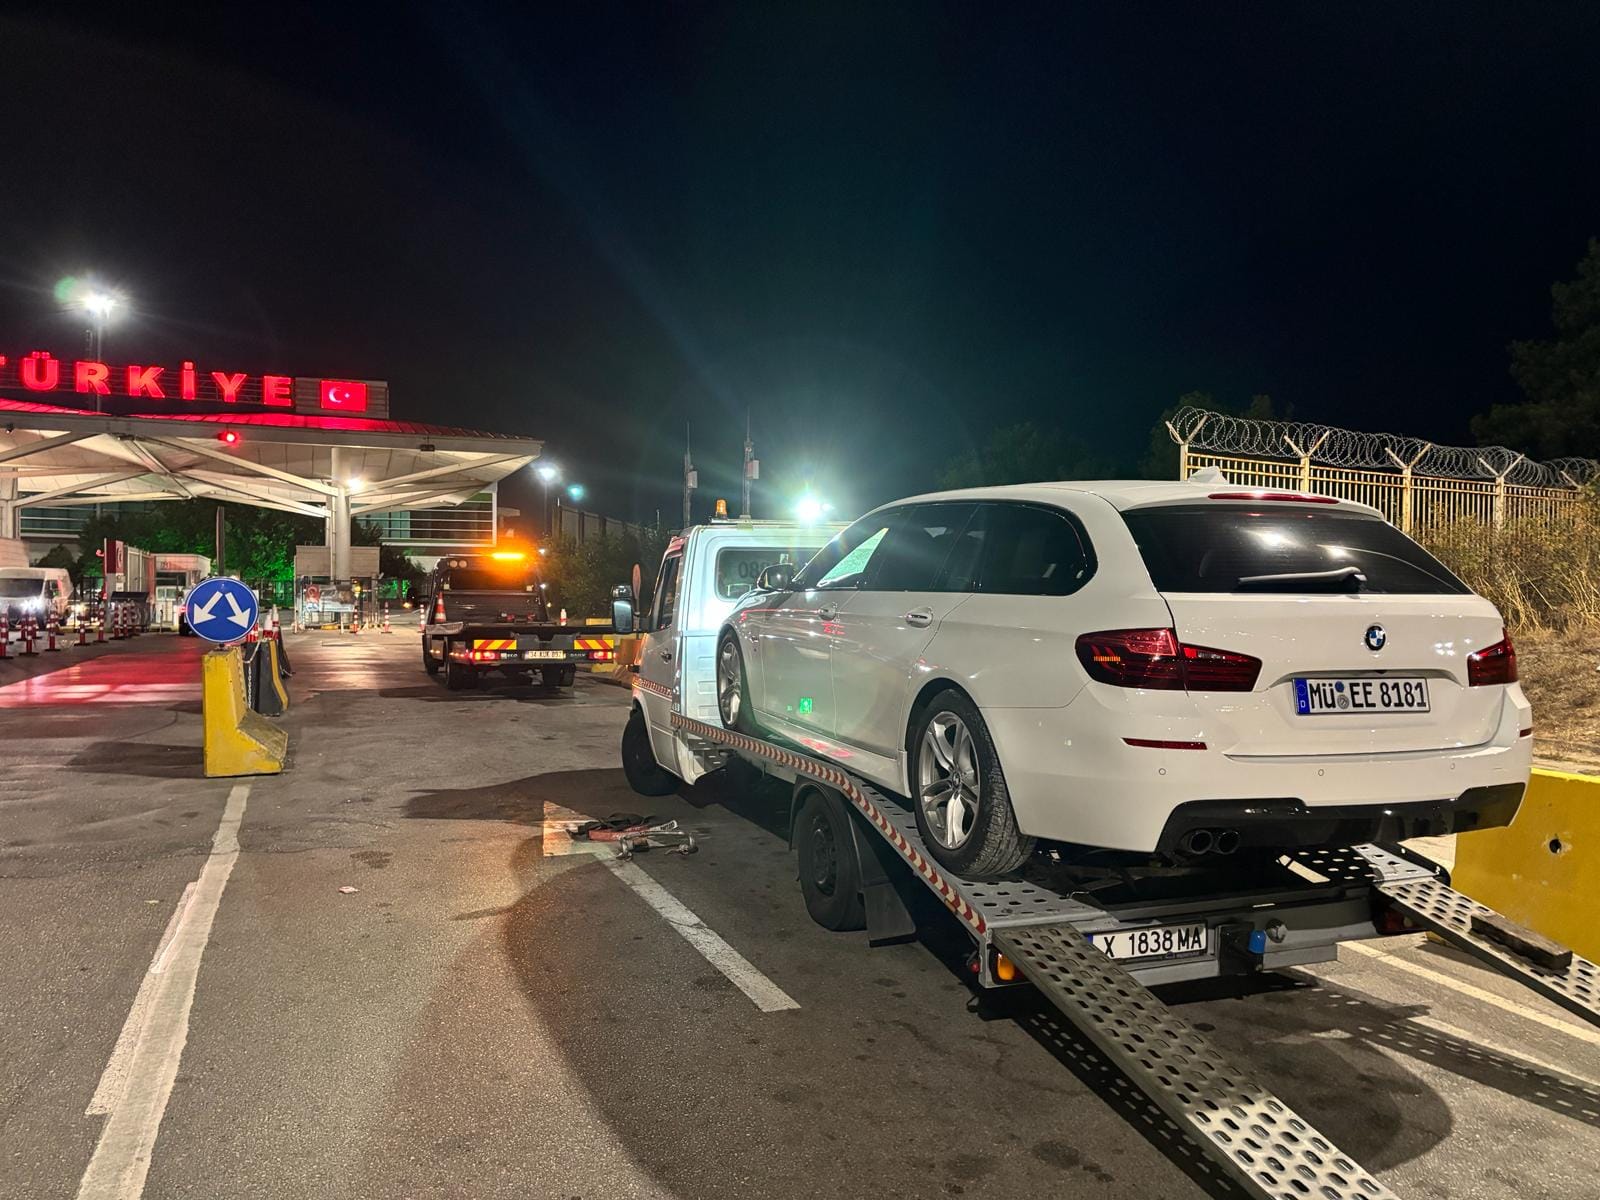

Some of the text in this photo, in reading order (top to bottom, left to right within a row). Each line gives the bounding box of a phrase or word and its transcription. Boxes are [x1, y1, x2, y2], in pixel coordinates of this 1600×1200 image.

[0, 351, 294, 407] ÜRKİYE
[1309, 682, 1427, 709] MÜ EE 8181
[1103, 926, 1202, 958] X 1838 MA
